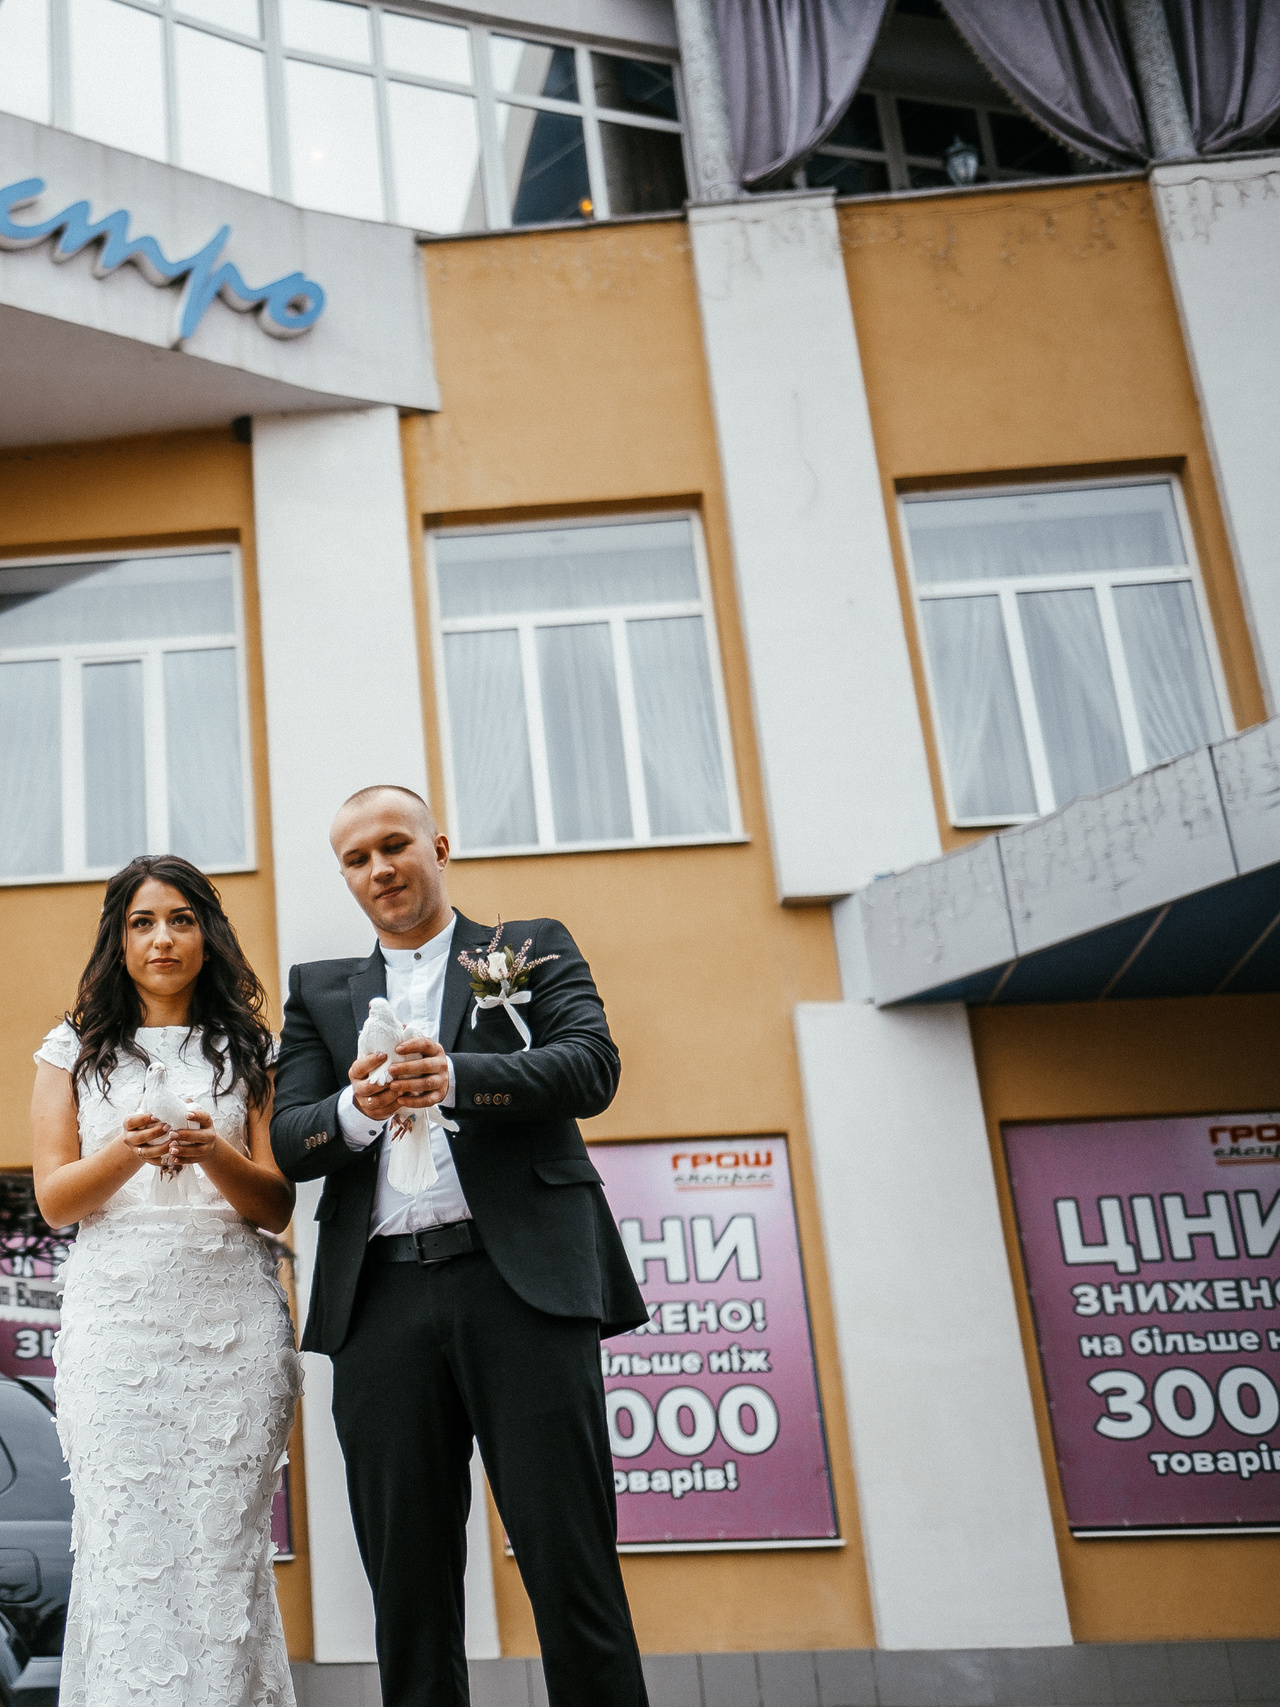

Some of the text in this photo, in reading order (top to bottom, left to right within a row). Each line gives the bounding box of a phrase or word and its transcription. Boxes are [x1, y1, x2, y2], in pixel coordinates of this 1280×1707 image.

[1071, 1278, 1280, 1316] ЗНИЖЕН
[1080, 1335, 1123, 1357] на
[1130, 1327, 1260, 1355] більше
[708, 1343, 773, 1374] ніж
